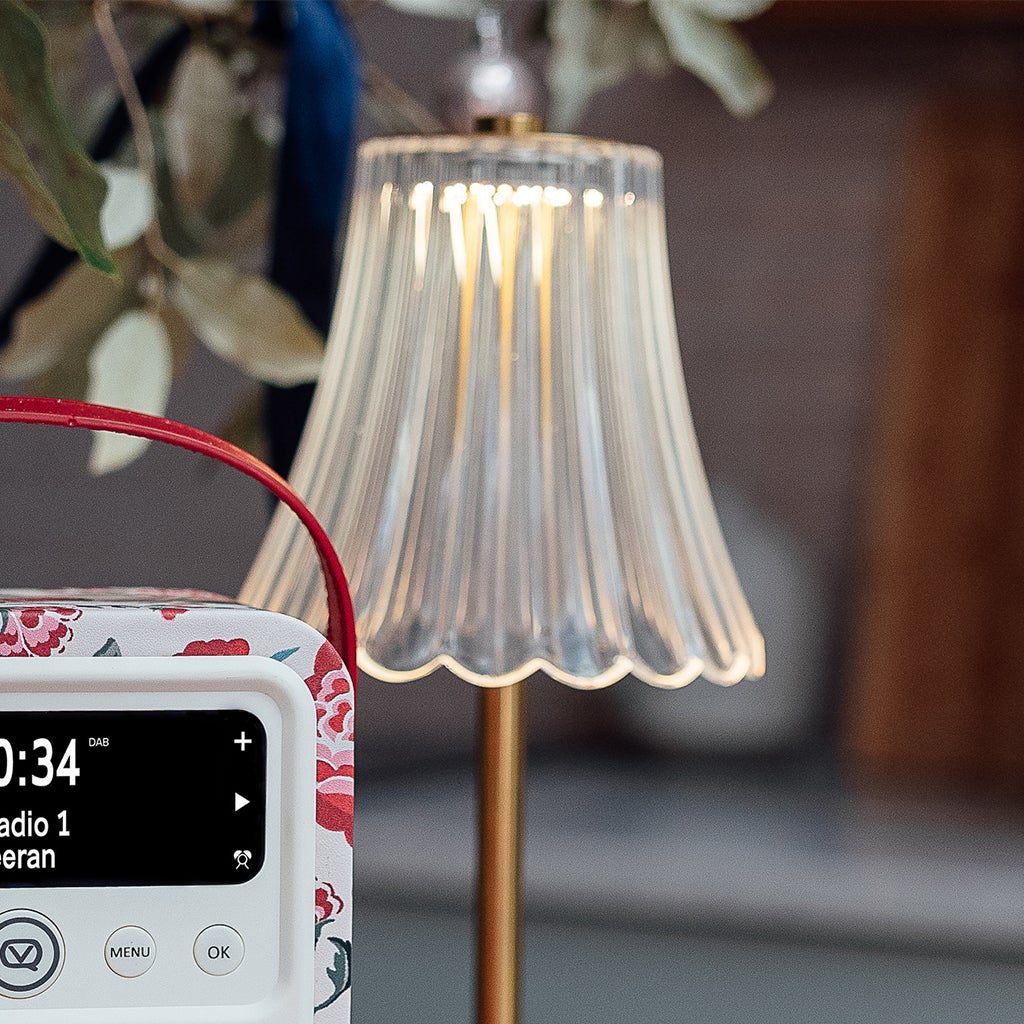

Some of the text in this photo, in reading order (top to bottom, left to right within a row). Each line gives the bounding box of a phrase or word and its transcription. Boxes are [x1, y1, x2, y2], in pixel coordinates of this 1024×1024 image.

[88, 737, 110, 748] DAB
[57, 809, 71, 837] 1
[110, 946, 150, 959] MENU
[207, 945, 231, 960] OK
